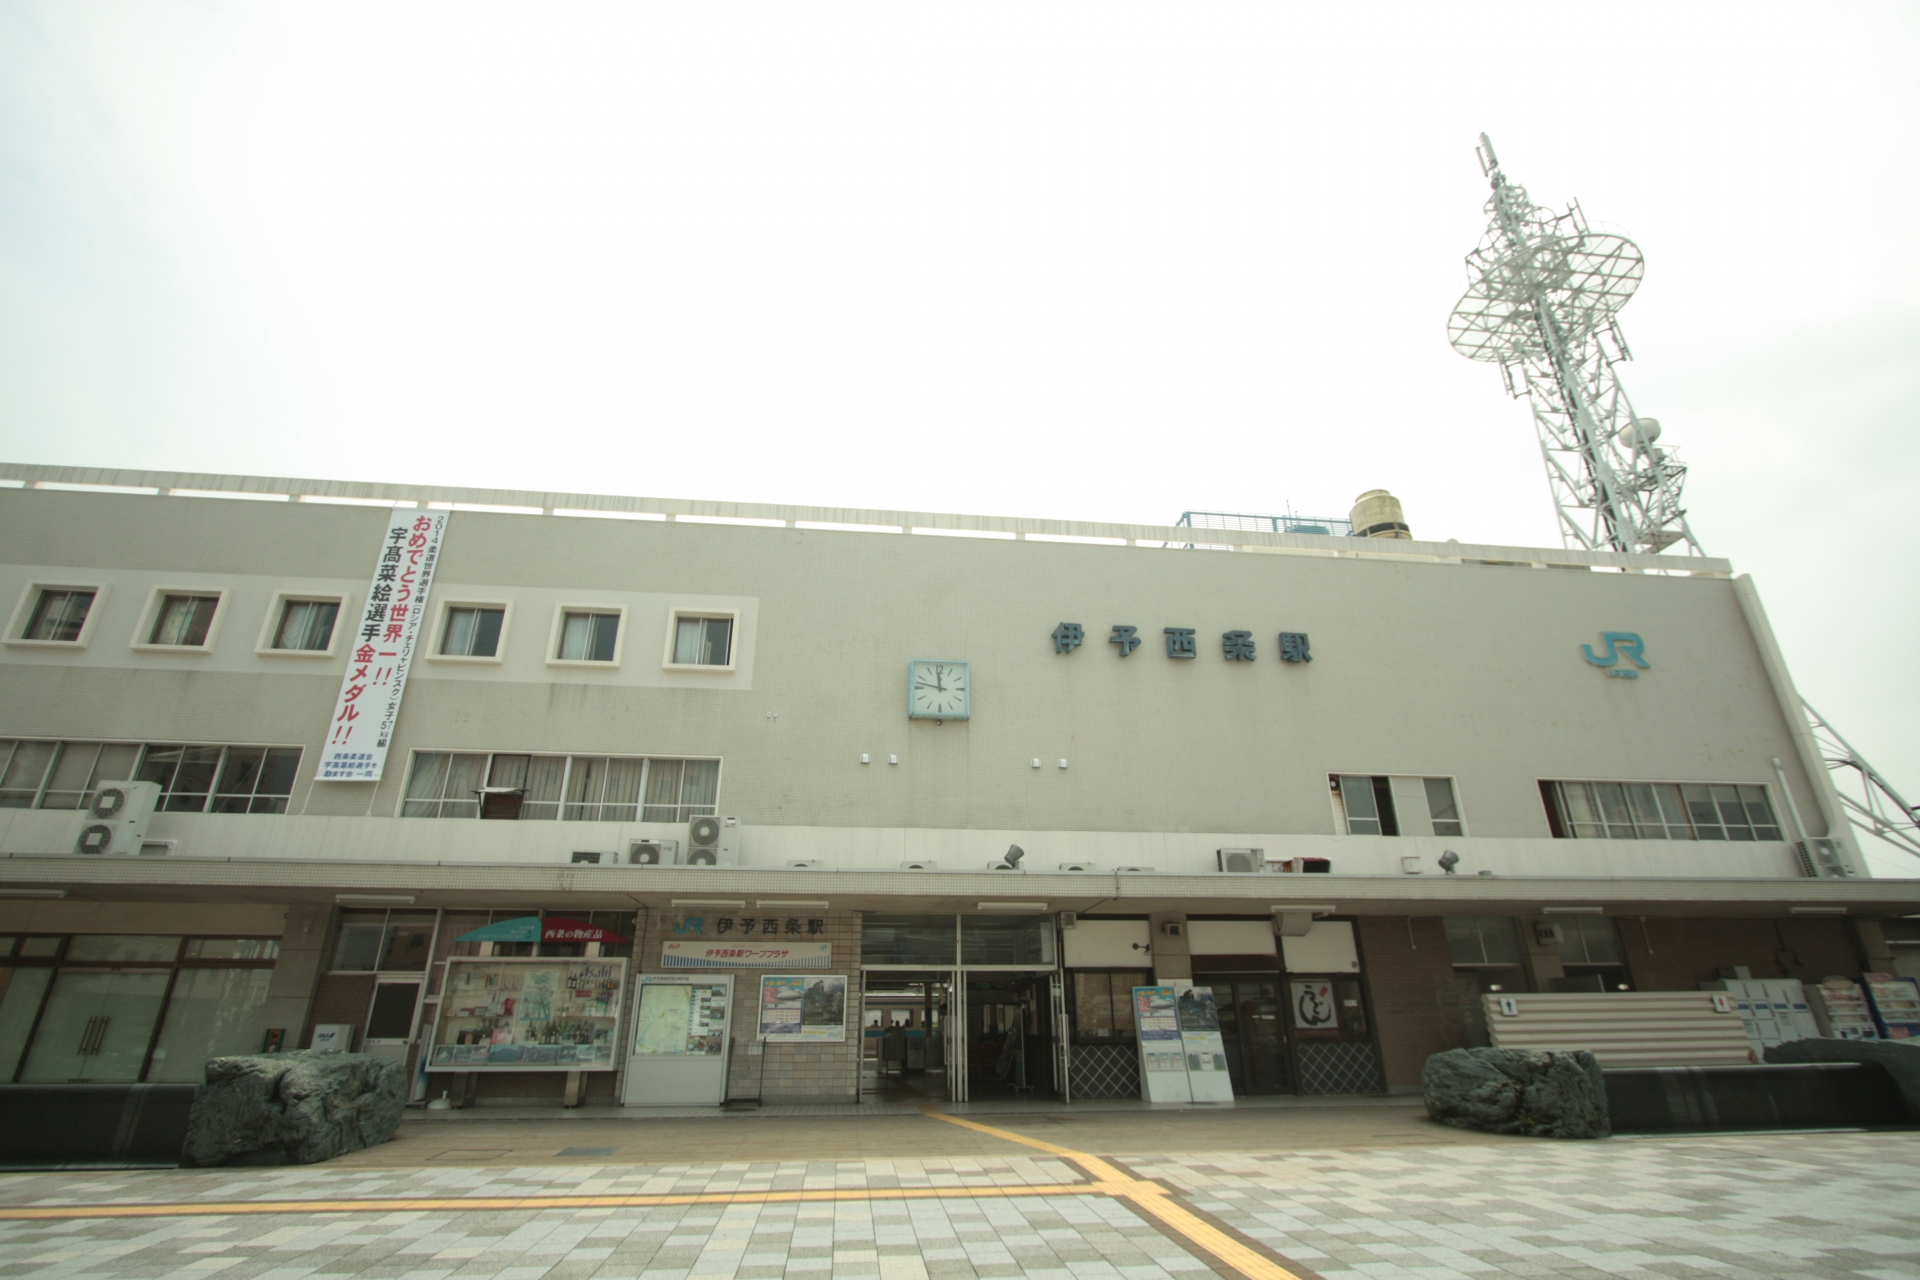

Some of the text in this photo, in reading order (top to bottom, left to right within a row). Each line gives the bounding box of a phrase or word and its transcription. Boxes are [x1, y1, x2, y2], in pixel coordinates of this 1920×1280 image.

[1051, 621, 1313, 664] 伊予西条駅
[1579, 631, 1651, 668] JR
[673, 917, 824, 934] JR 伊予西条駅
[544, 928, 603, 939] 西条の物産品
[705, 949, 789, 958] 伊予西条駅ワーププラザ
[579, 965, 612, 979] Asahi
